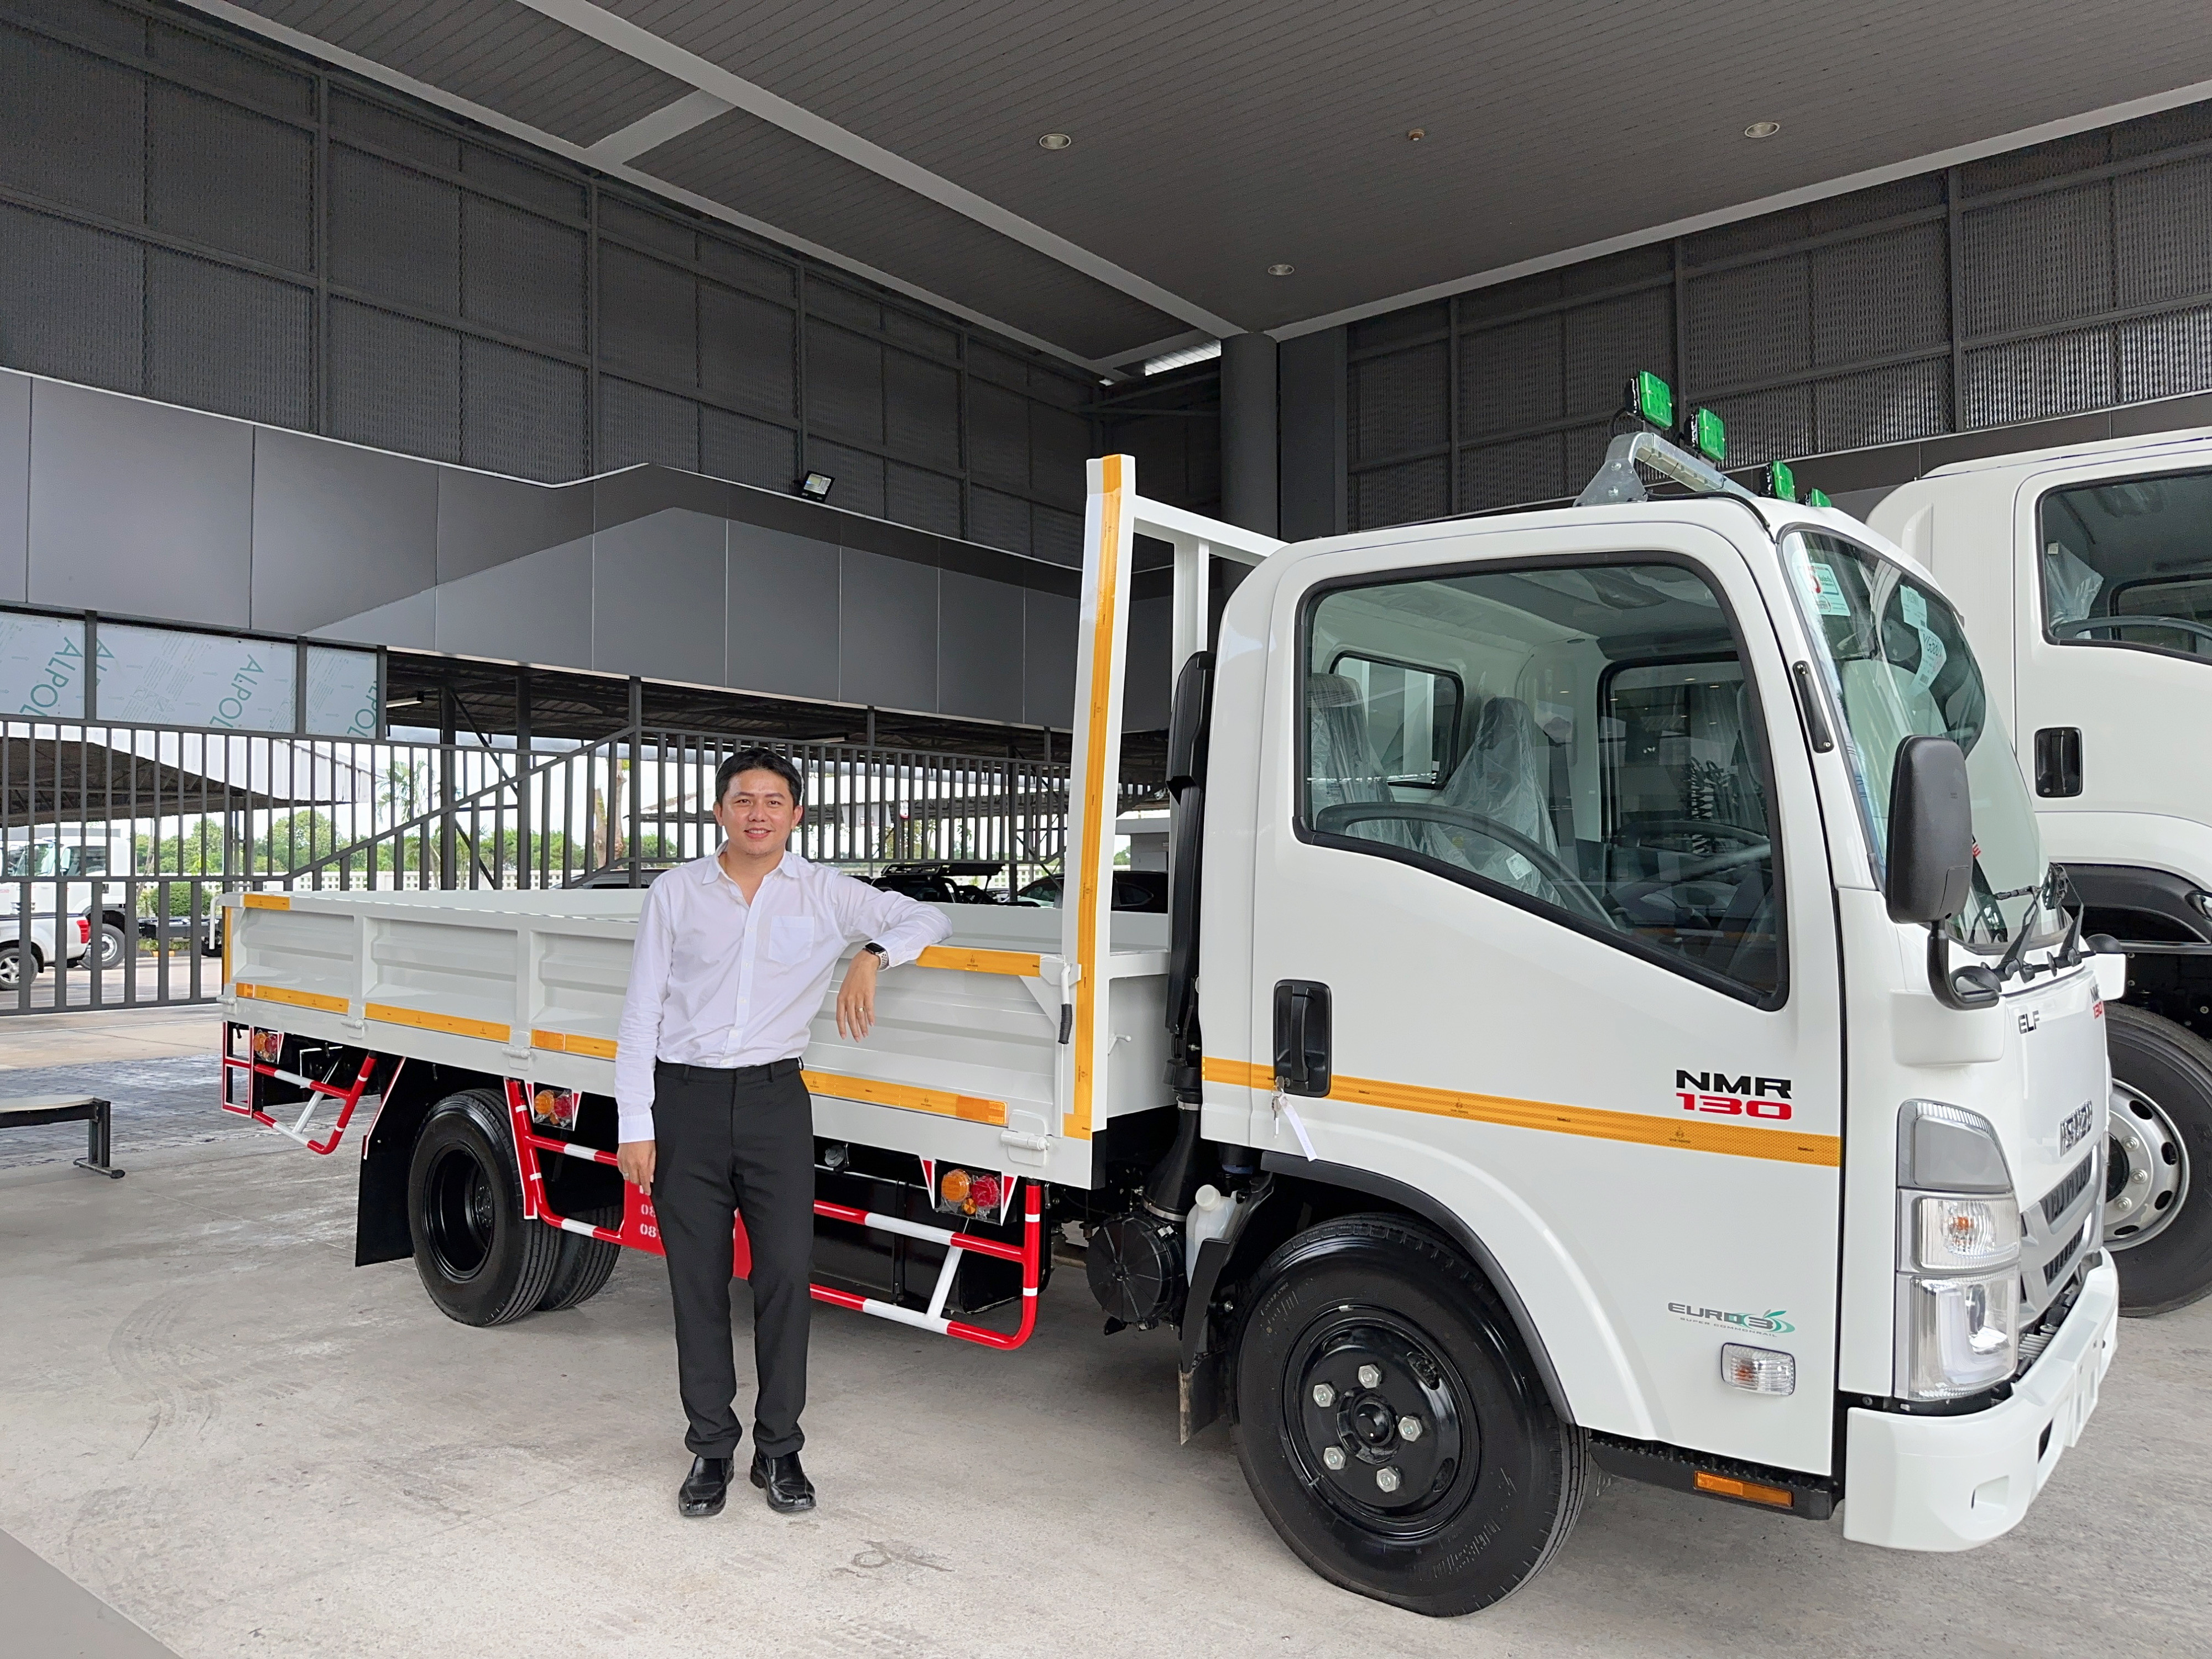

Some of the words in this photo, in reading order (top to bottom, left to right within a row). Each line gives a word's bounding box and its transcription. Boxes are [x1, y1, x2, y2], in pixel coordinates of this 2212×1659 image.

[2018, 1010, 2040, 1034] ELF
[1676, 1070, 1792, 1099] NMR
[1676, 1092, 1792, 1120] 130
